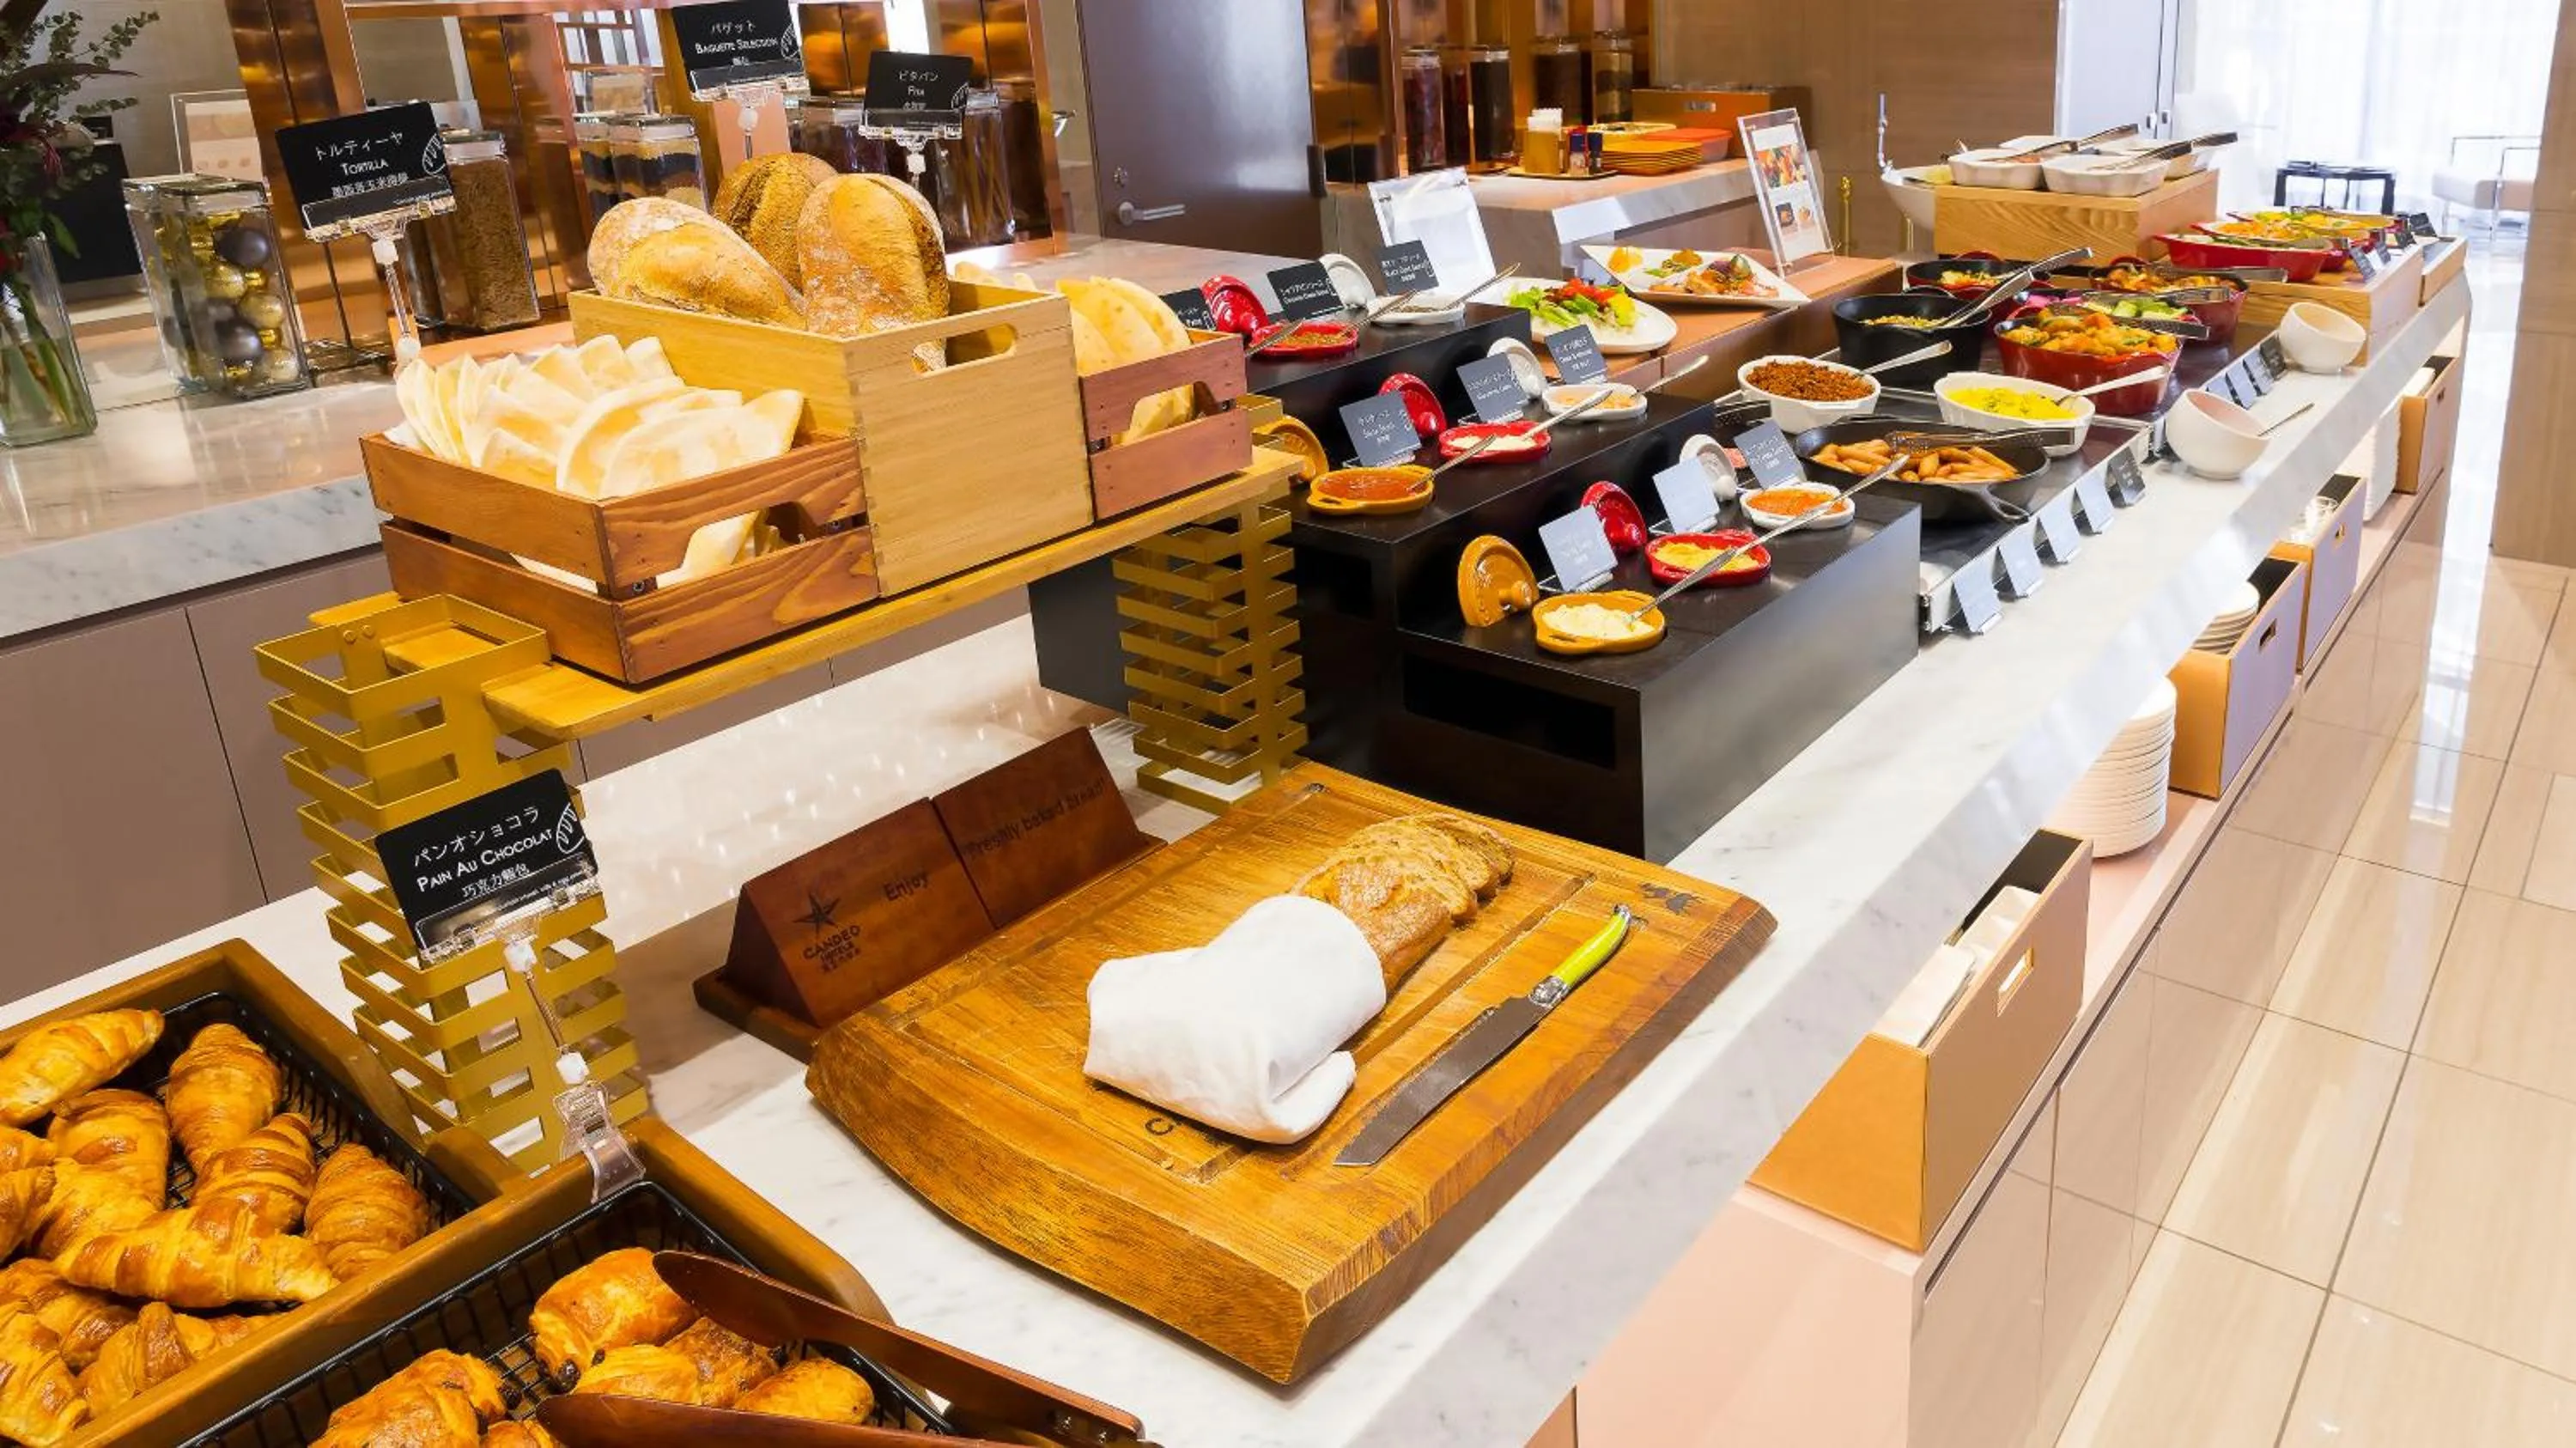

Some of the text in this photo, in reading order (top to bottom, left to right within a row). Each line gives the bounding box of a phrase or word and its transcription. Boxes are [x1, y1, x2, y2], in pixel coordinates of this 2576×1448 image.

[316, 131, 403, 161] トルティーヤ
[414, 806, 539, 867] パンオショコラ
[416, 829, 552, 893] PAIN AU CHOCOLAT
[884, 872, 927, 901] Enjoy
[802, 924, 860, 959] CANDEO
